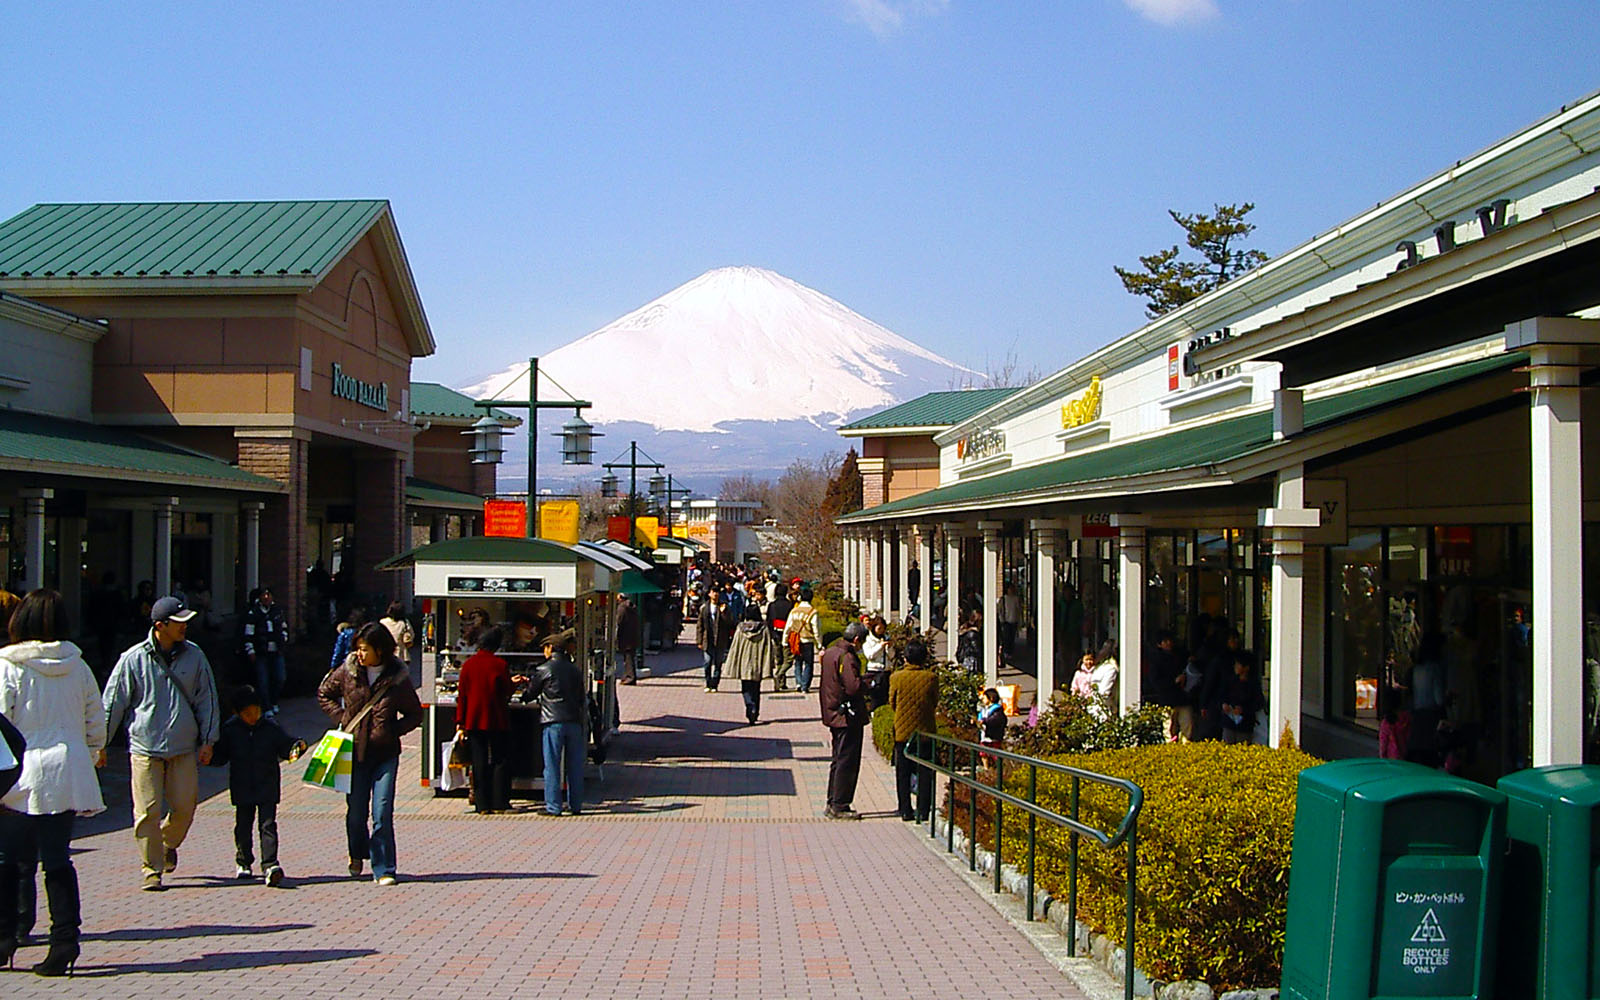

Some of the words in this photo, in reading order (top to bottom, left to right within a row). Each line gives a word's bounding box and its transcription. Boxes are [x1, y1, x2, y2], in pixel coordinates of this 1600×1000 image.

[332, 363, 357, 401] FOOD
[357, 380, 388, 412] BAZAAR
[1403, 947, 1450, 957] RECYCLE
[1403, 956, 1449, 966] BOTTLES
[1413, 966, 1437, 974] ONLY
